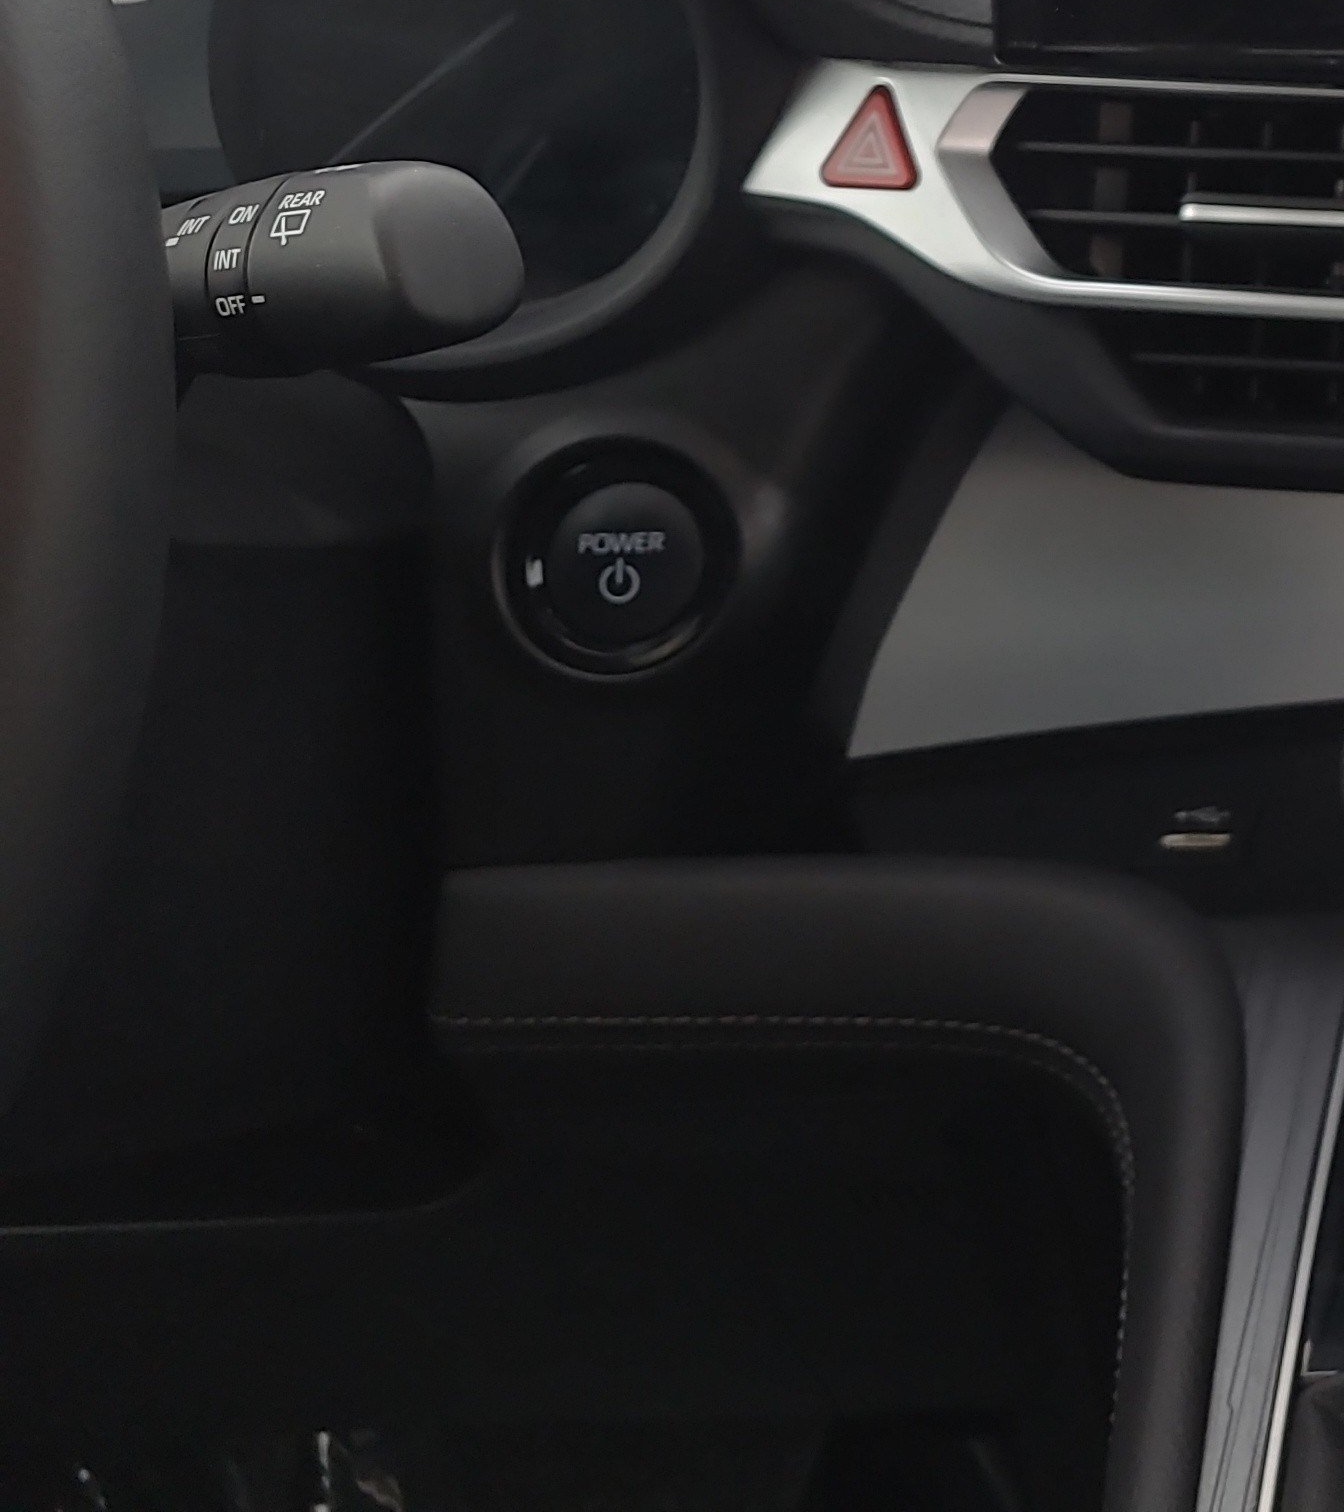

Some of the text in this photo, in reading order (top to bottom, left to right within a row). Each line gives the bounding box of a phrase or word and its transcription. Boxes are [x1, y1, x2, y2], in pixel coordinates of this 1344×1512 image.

[278, 189, 326, 209] REAR
[228, 204, 260, 225] ON
[177, 215, 211, 237] INT
[213, 248, 242, 270] INT
[215, 294, 246, 317] OFF
[577, 531, 667, 554] POWER
